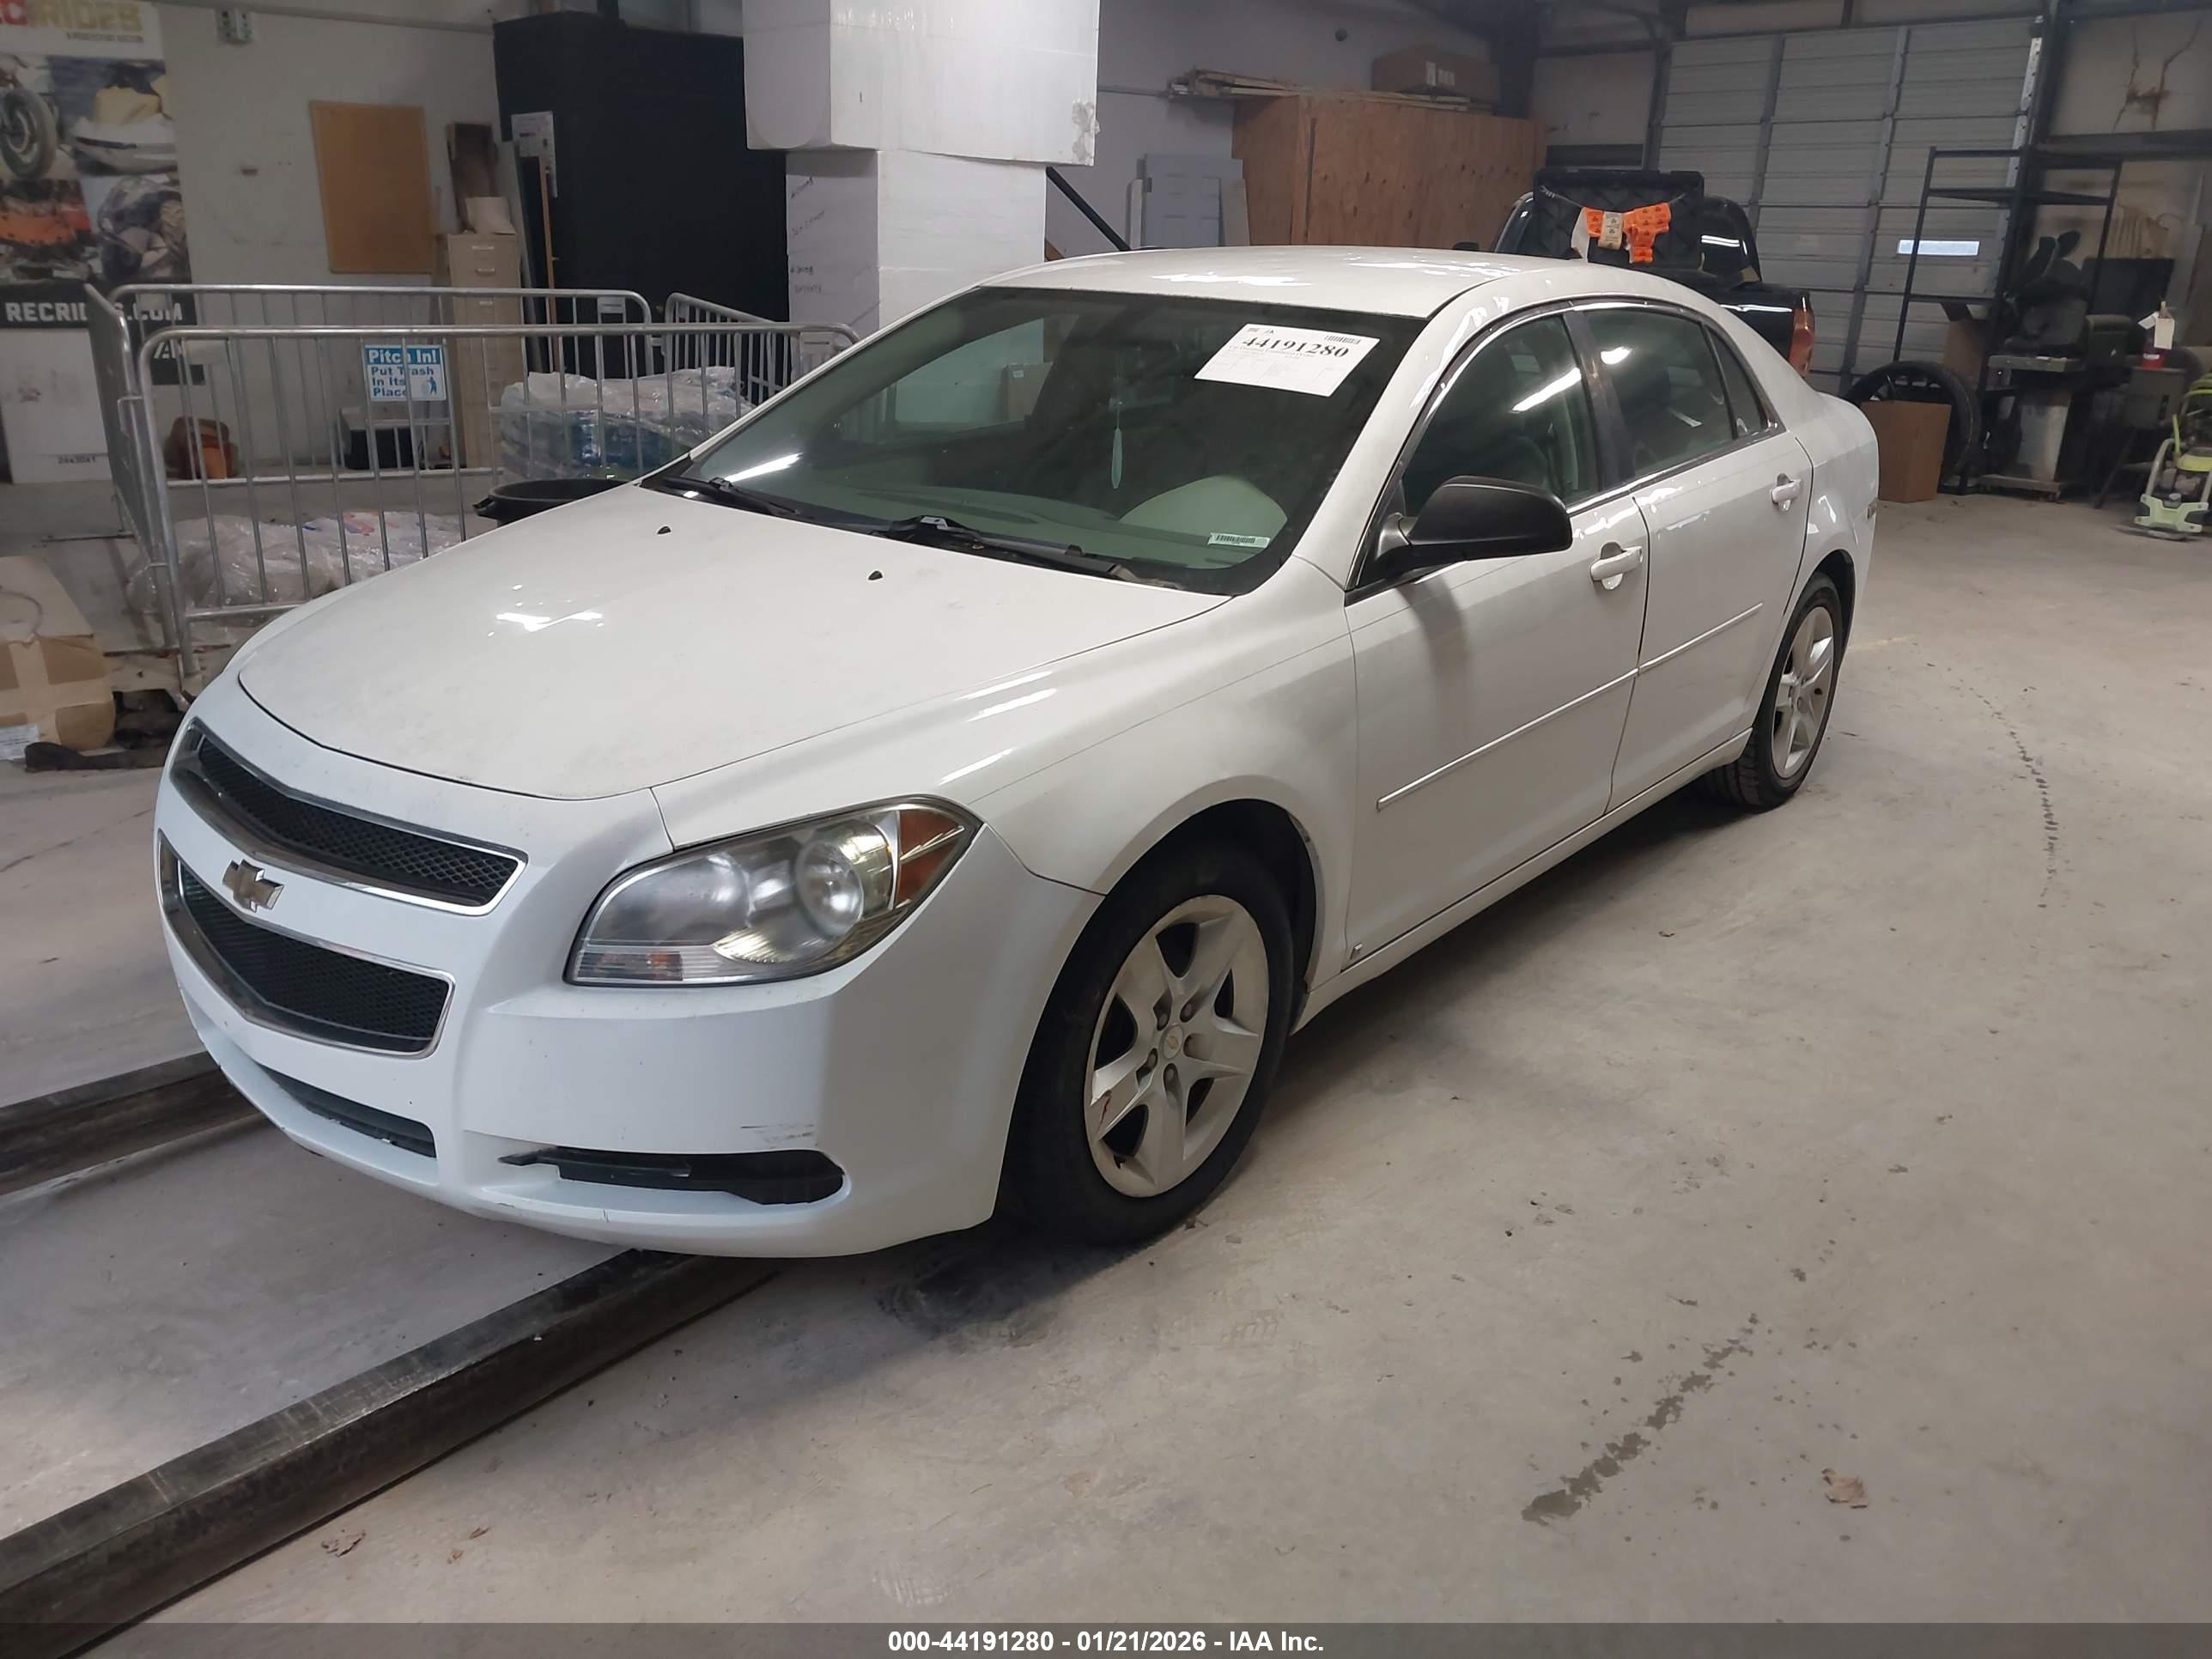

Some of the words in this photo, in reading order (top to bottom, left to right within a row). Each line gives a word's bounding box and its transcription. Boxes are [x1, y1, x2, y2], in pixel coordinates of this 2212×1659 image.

[5, 302, 183, 322] RECRI.COM
[416, 349, 437, 363] In!
[1243, 337, 1350, 358] 44191280
[371, 367, 392, 376] Put
[397, 367, 434, 376] Tash
